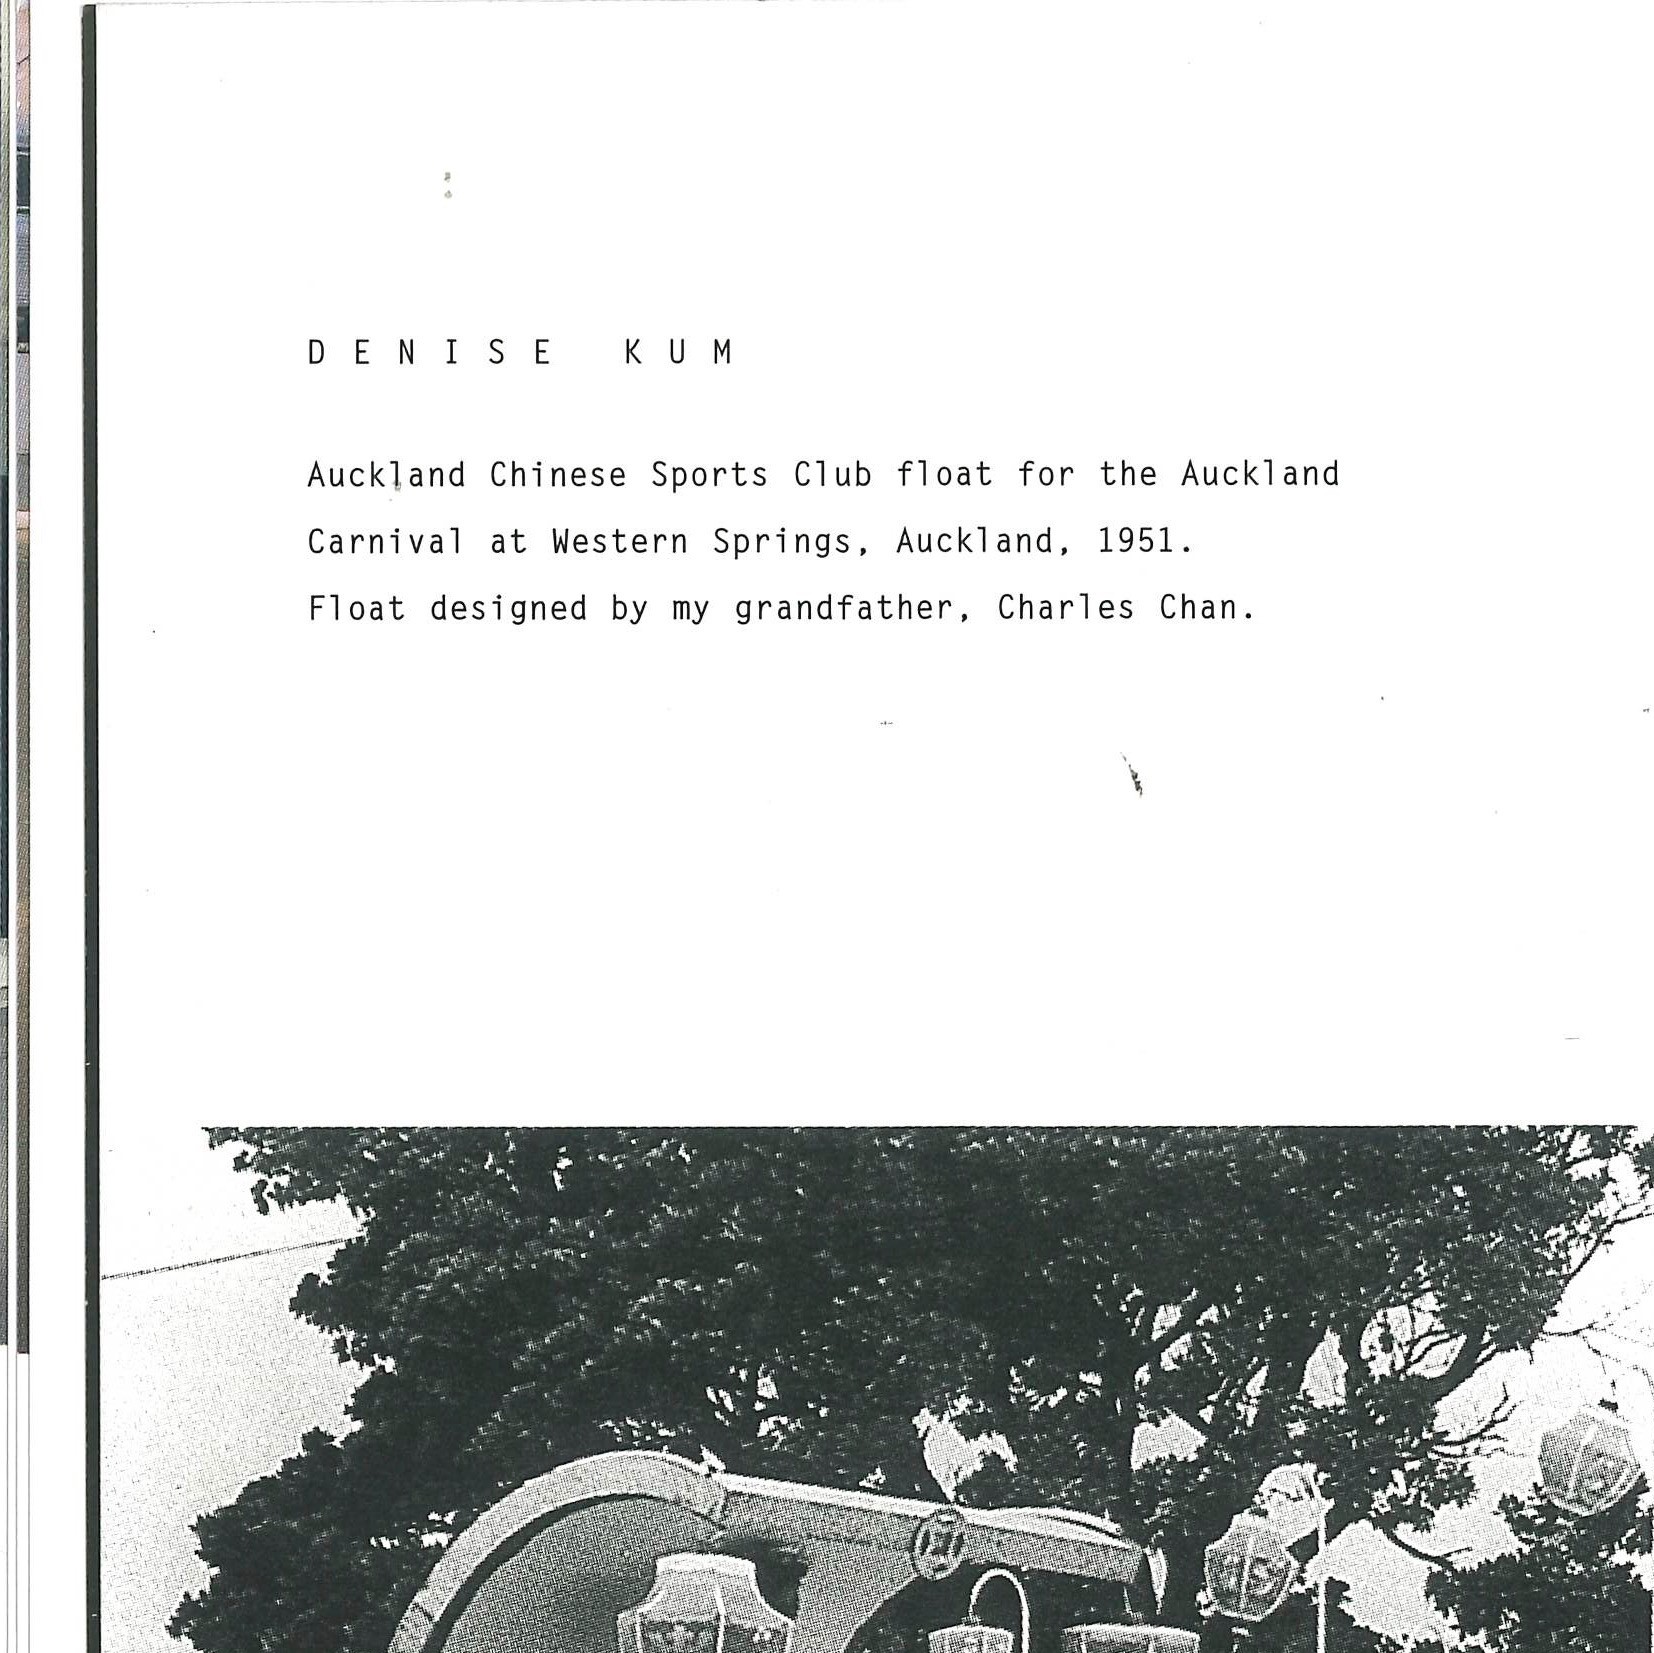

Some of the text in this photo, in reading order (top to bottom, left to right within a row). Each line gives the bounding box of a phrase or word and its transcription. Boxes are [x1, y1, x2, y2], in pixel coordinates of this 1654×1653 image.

[309, 339, 730, 364] DENISE KUM
[308, 459, 1338, 493] Auckland Chinese Sports Club float for the Auckland
[309, 527, 1189, 559] Carnival at Western Springs, Auckland, 1951.
[311, 593, 1251, 625] Float designed by my grandfather, Charles Chan.
